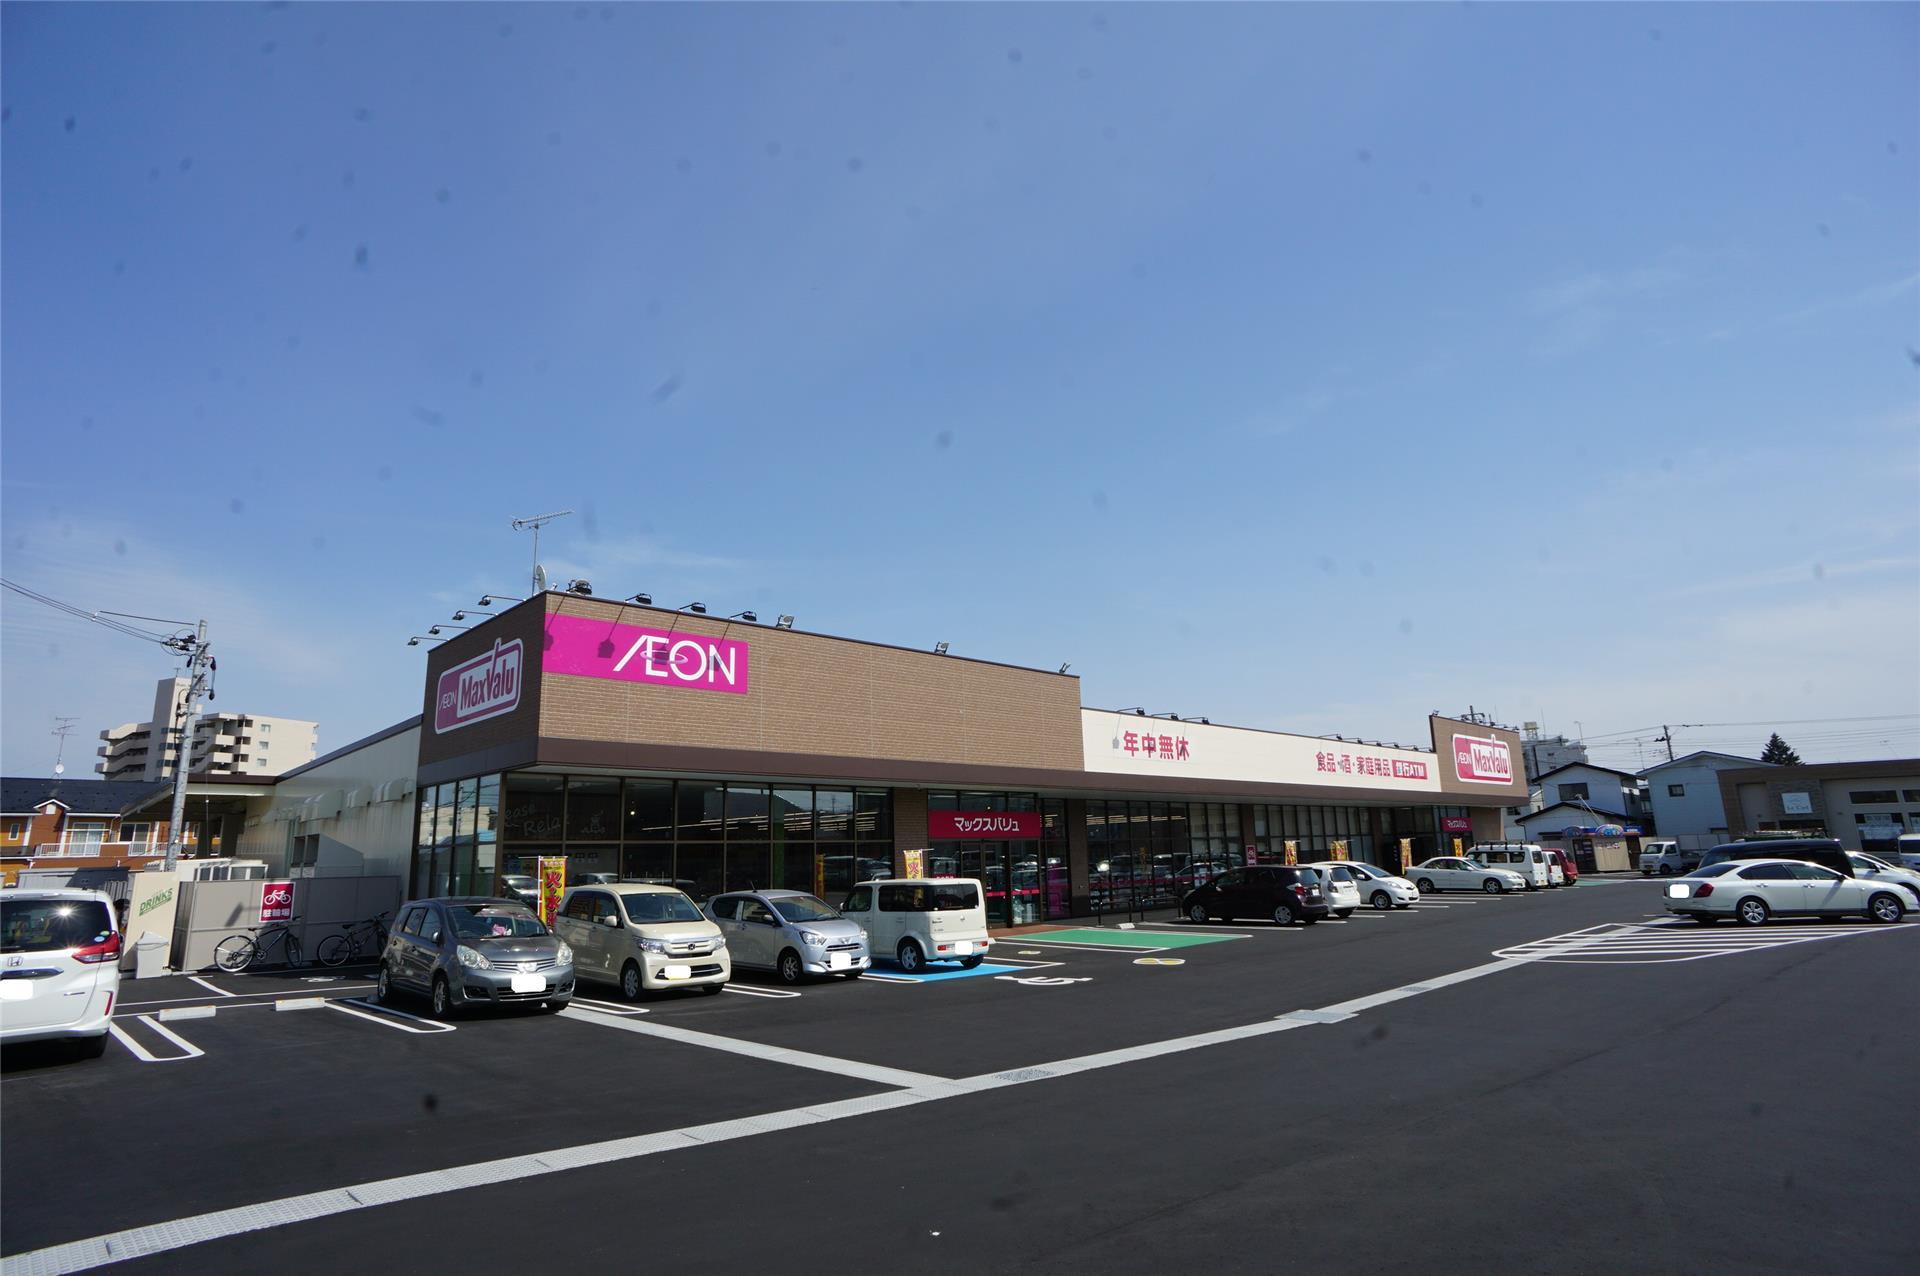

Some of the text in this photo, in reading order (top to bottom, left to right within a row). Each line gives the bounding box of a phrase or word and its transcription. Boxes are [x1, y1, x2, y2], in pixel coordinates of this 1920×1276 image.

[460, 642, 515, 711] MaxValu
[1123, 730, 1190, 760] 年中無休
[1473, 737, 1508, 774] MaxValu
[954, 817, 1020, 832] マックスバリュ
[139, 887, 174, 913] DRINKS
